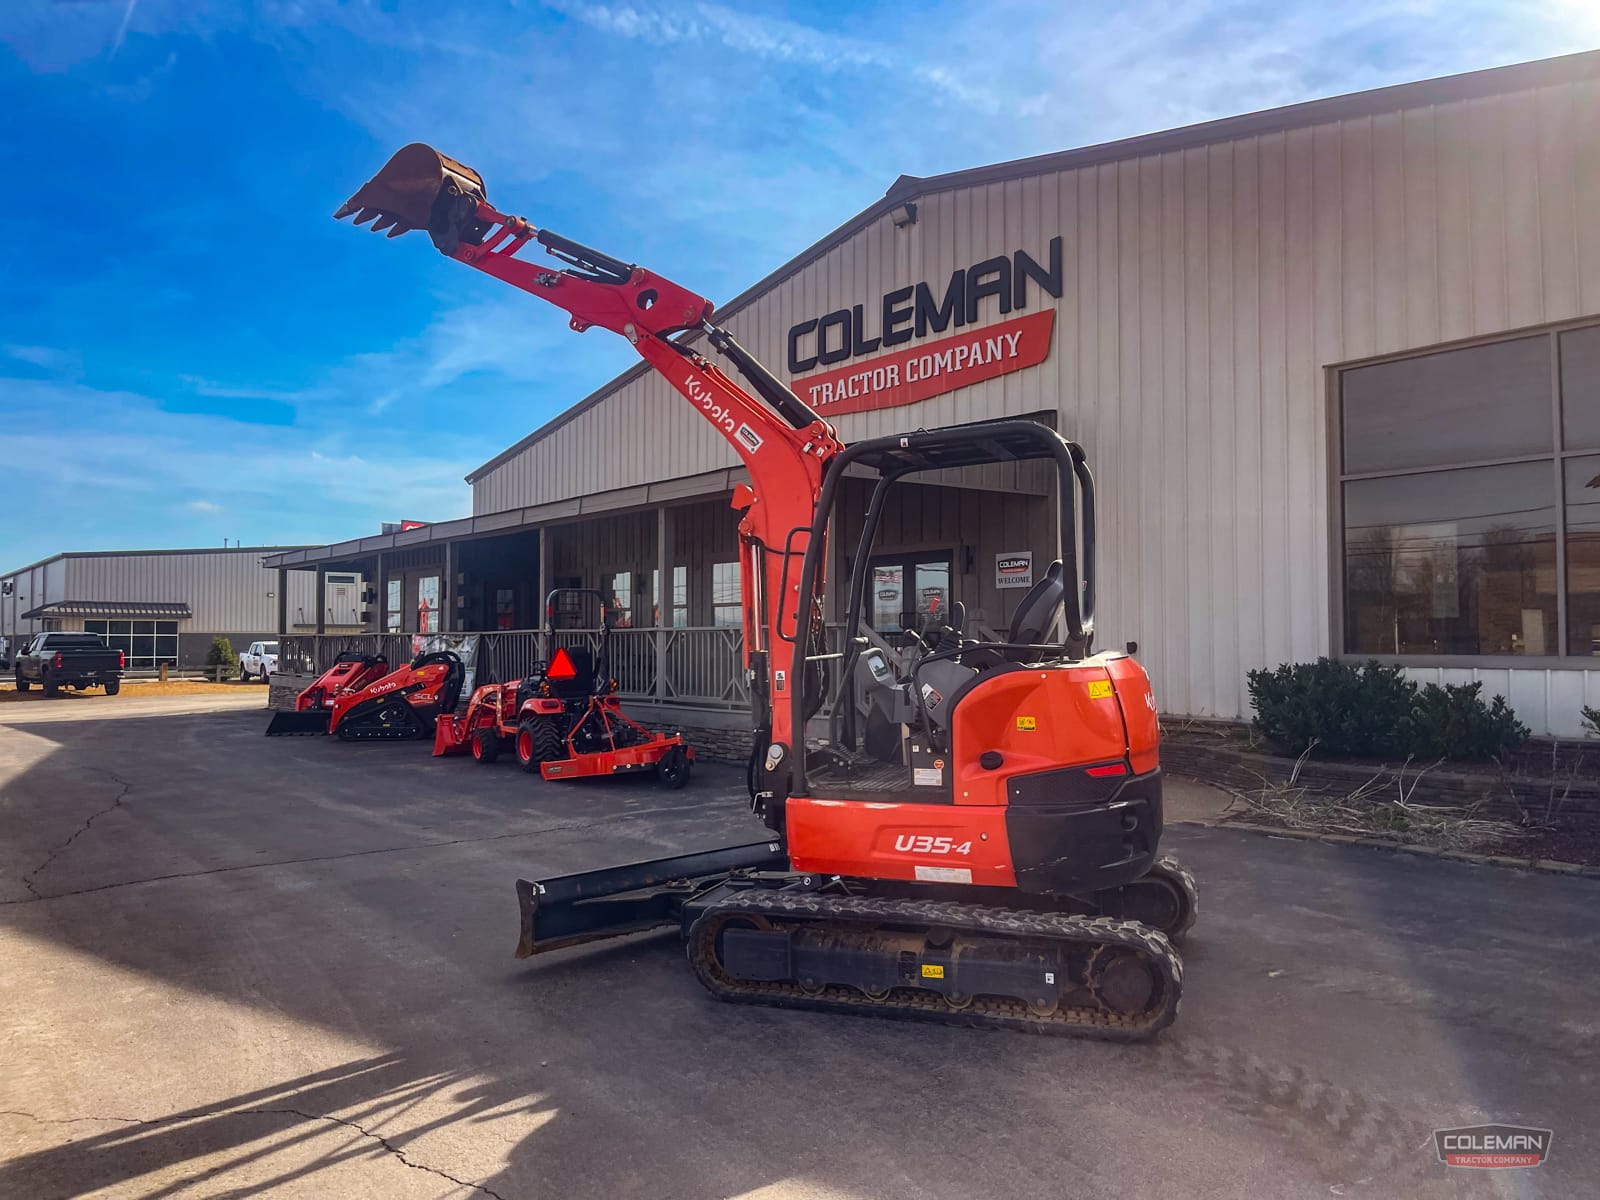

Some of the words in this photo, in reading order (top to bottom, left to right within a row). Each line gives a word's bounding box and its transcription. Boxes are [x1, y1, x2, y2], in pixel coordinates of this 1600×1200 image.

[788, 236, 1063, 374] COLEMAN
[809, 364, 900, 408] TRACTOR
[906, 331, 1023, 384] COMPANY
[684, 374, 736, 432] Kubota
[998, 576, 1030, 584] WELCOME
[369, 682, 397, 693] Kubota
[894, 834, 972, 855] U35-4
